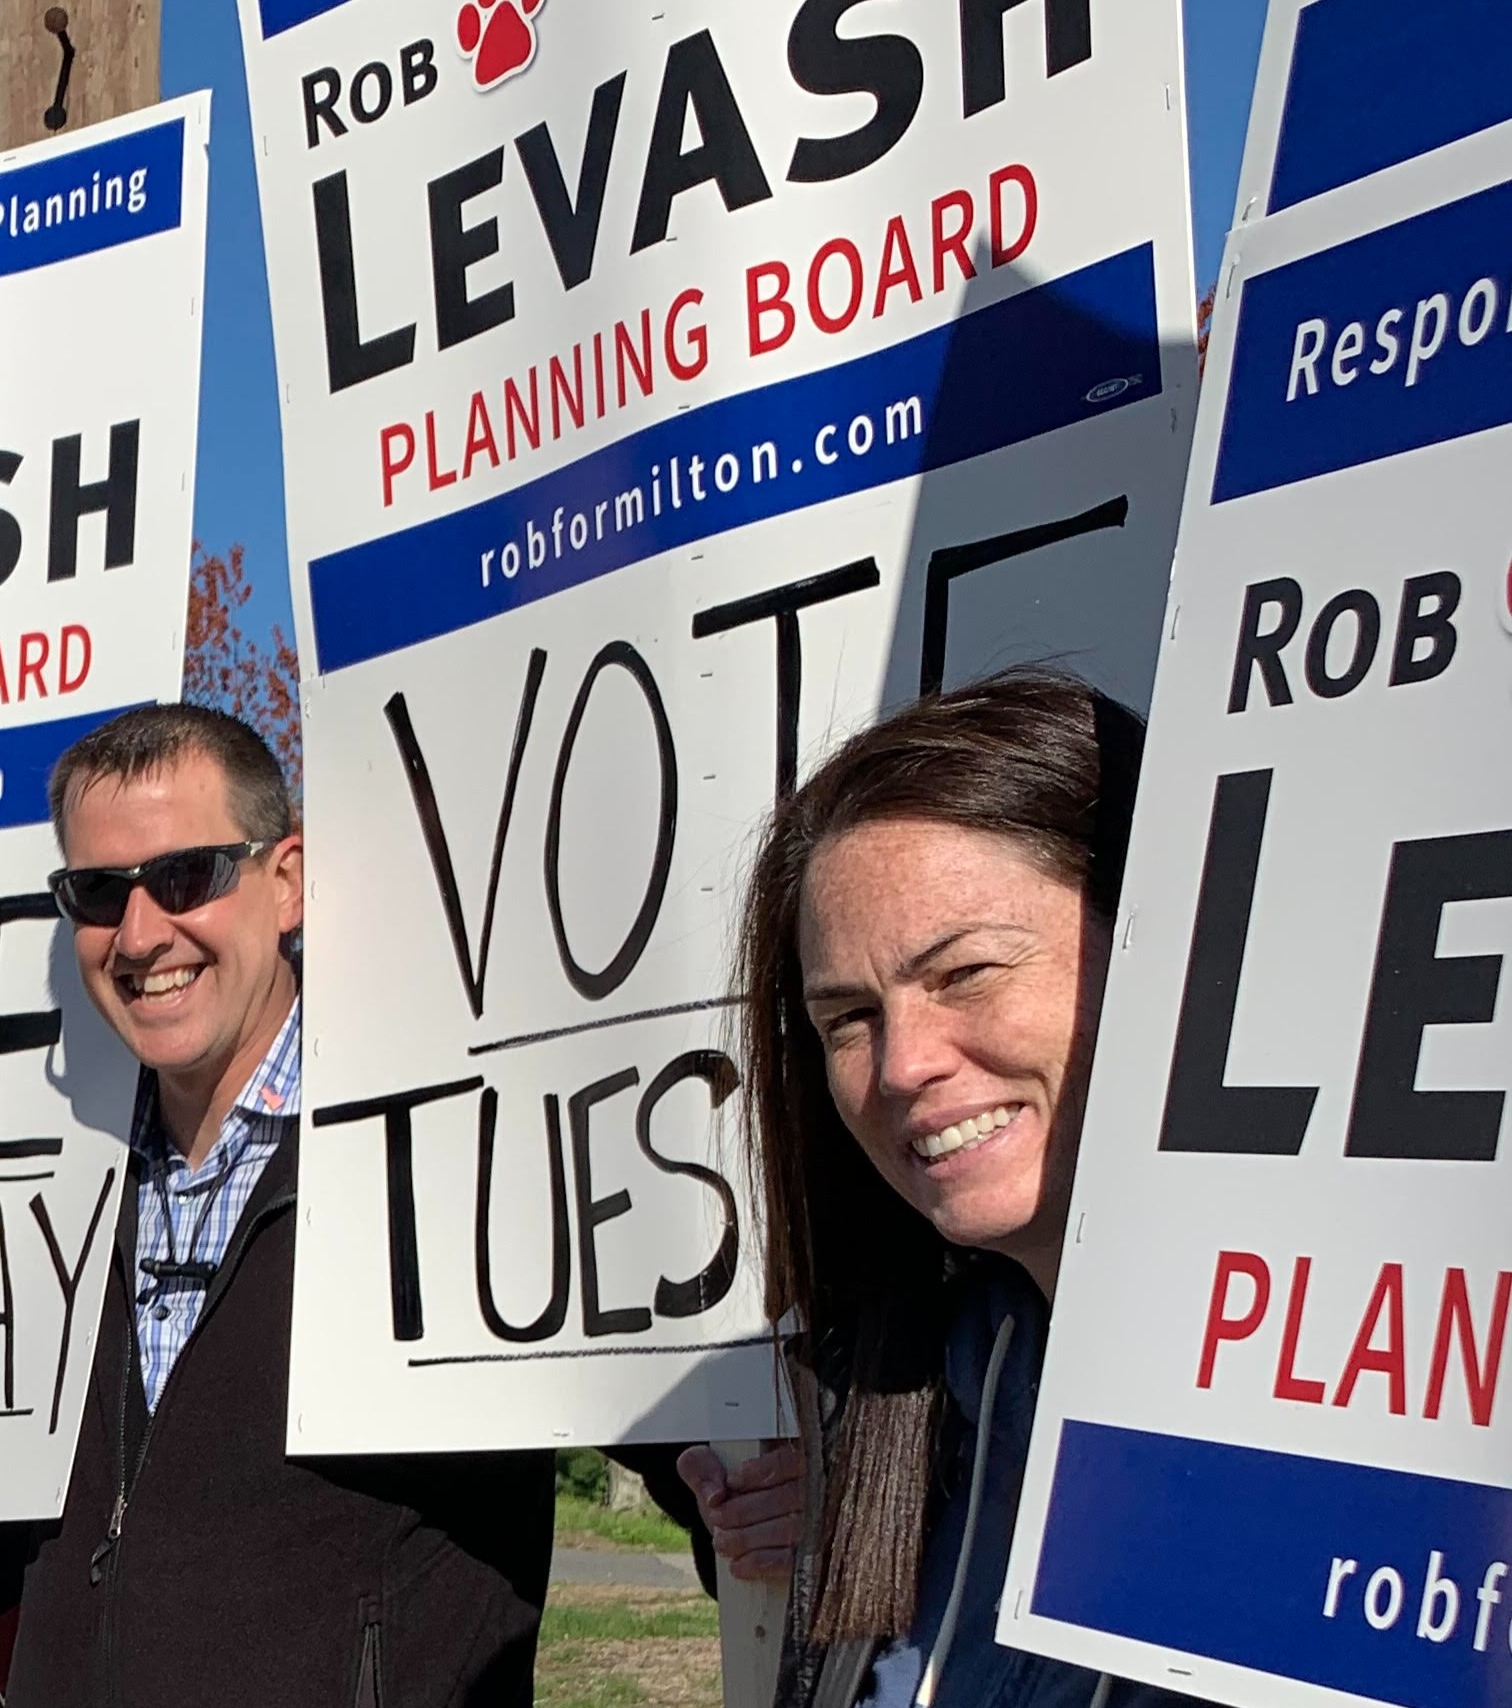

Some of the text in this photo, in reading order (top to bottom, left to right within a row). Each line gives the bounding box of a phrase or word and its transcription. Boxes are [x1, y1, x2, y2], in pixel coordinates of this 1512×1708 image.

[380, 164, 1038, 507] PLANNING BOARD
[1286, 277, 1512, 403] Respo
[481, 394, 923, 587] robformilton.com
[384, 495, 1128, 1020] VOT
[1322, 1550, 1512, 1656] robf
